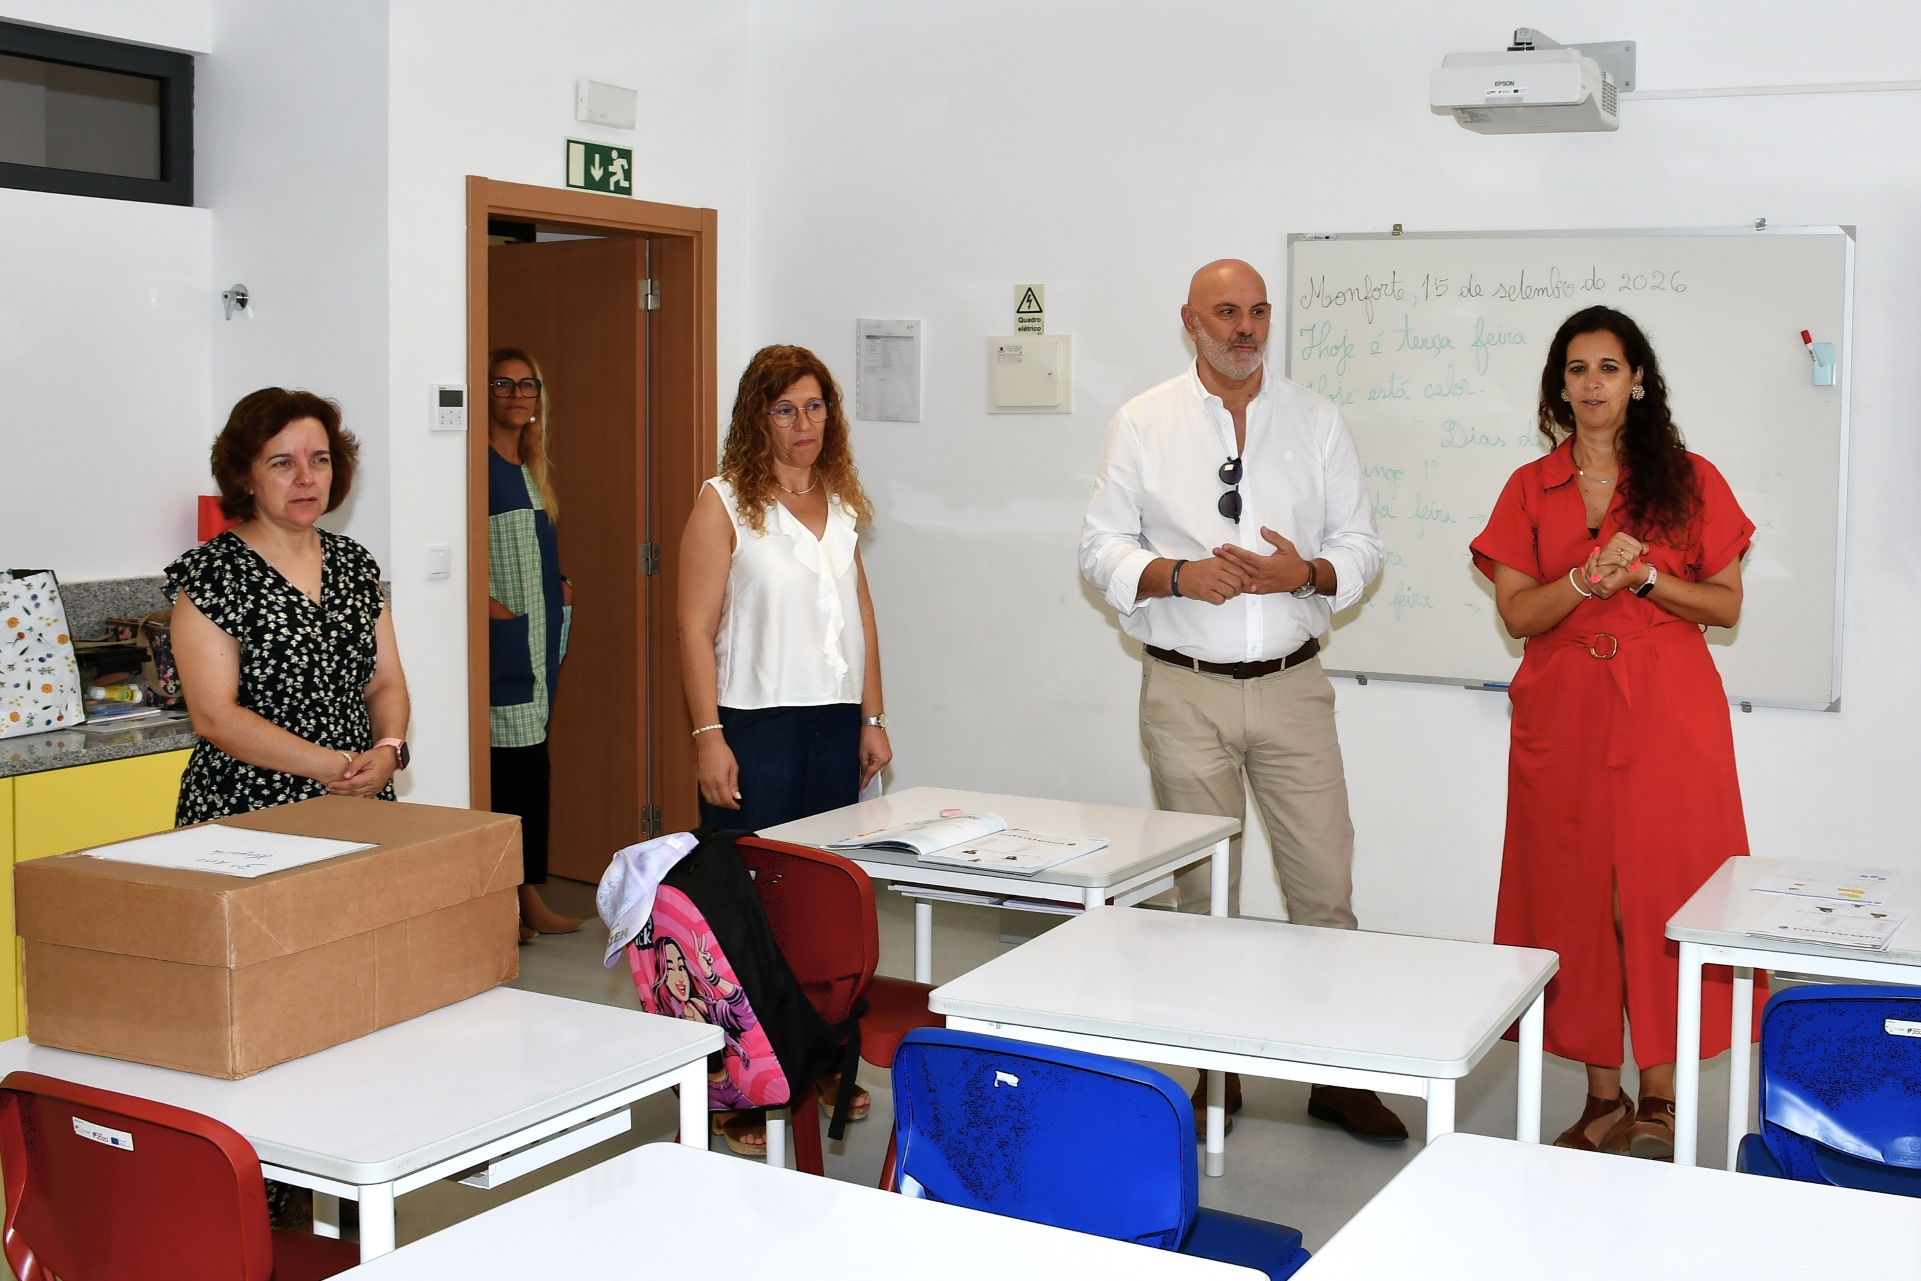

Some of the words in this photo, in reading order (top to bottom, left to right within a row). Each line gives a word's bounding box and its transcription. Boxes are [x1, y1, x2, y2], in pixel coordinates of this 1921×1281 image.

[1421, 273, 1450, 301] 15
[1458, 273, 1484, 298] de
[1580, 265, 1606, 292] de
[1618, 270, 1687, 293] 2026
[1017, 316, 1042, 324] Quadro
[1017, 325, 1042, 333] elétrico
[1368, 330, 1385, 355] é
[1393, 313, 1456, 359] terça
[1366, 372, 1411, 401] está
[1440, 419, 1507, 449] Dias
[1363, 462, 1406, 500] ingo
[1407, 491, 1456, 540] feira
[608, 927, 630, 946] ZEN
